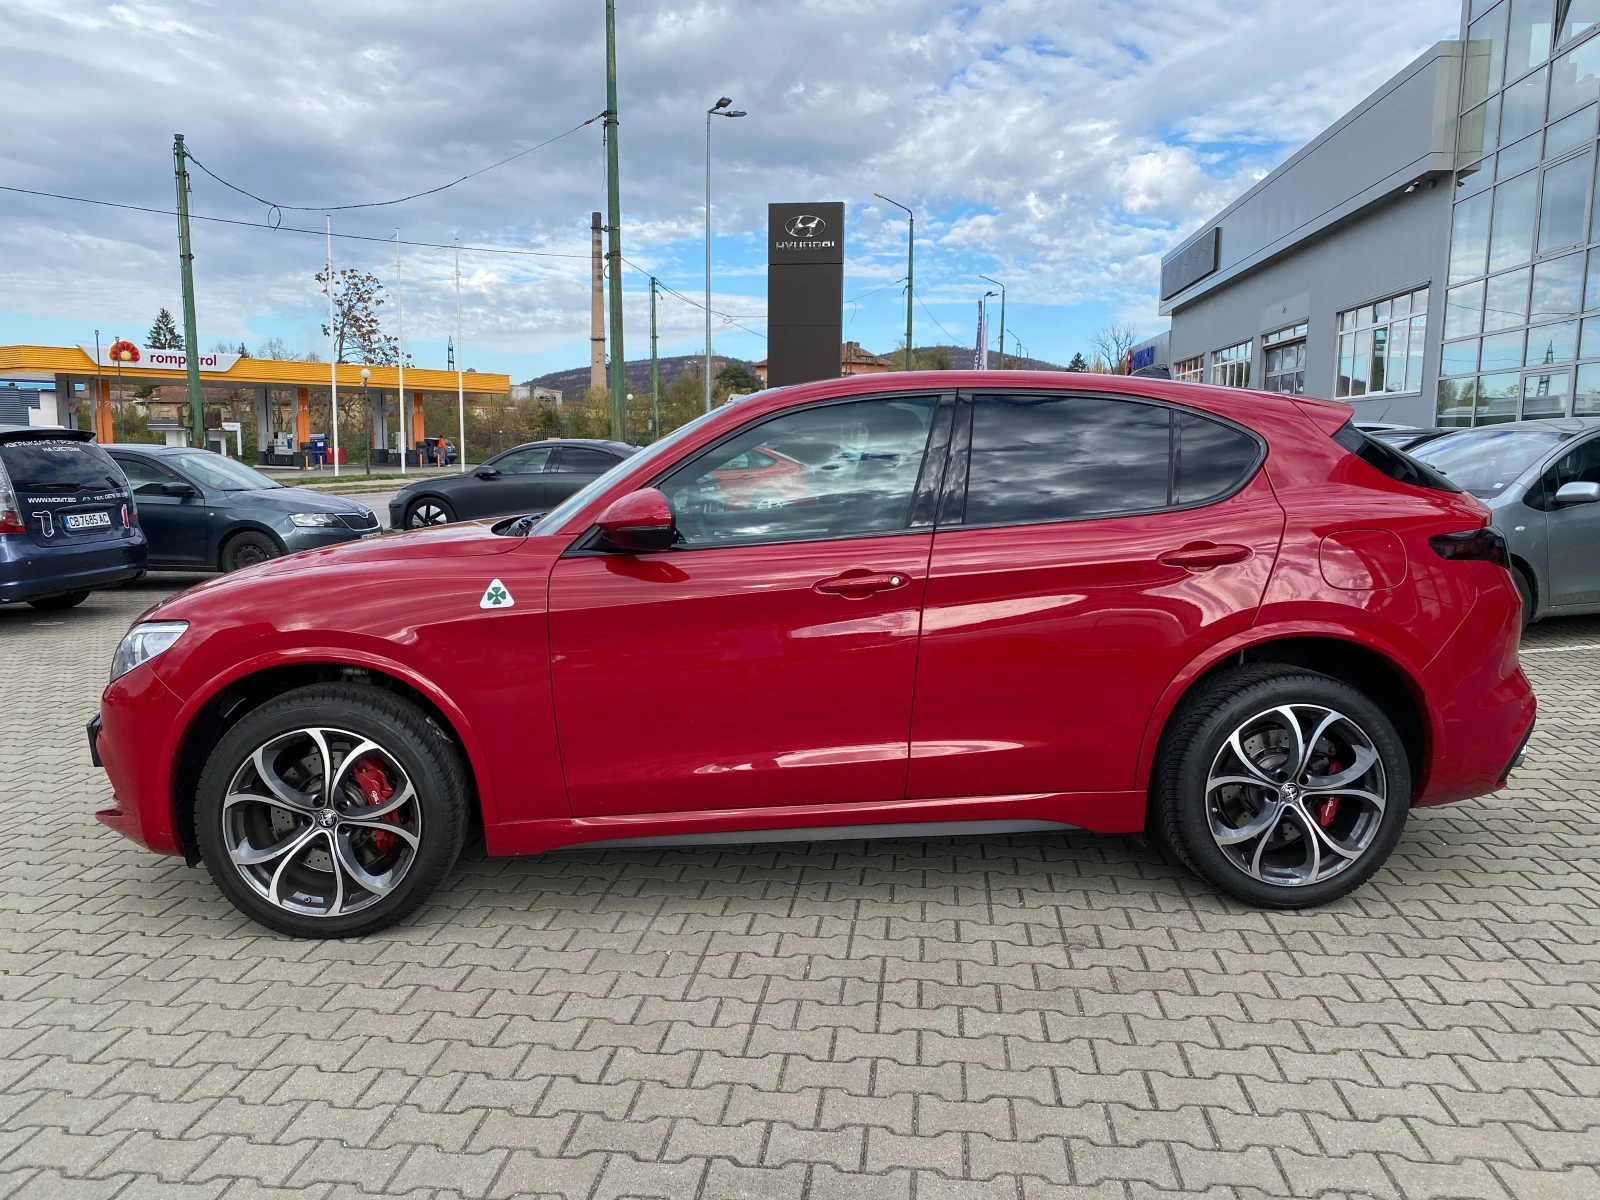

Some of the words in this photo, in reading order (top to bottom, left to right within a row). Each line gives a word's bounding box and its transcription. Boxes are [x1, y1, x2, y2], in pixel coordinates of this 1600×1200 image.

[775, 240, 835, 252] HYUNDAI
[150, 354, 217, 368] romprol
[80, 514, 99, 526] 7685
